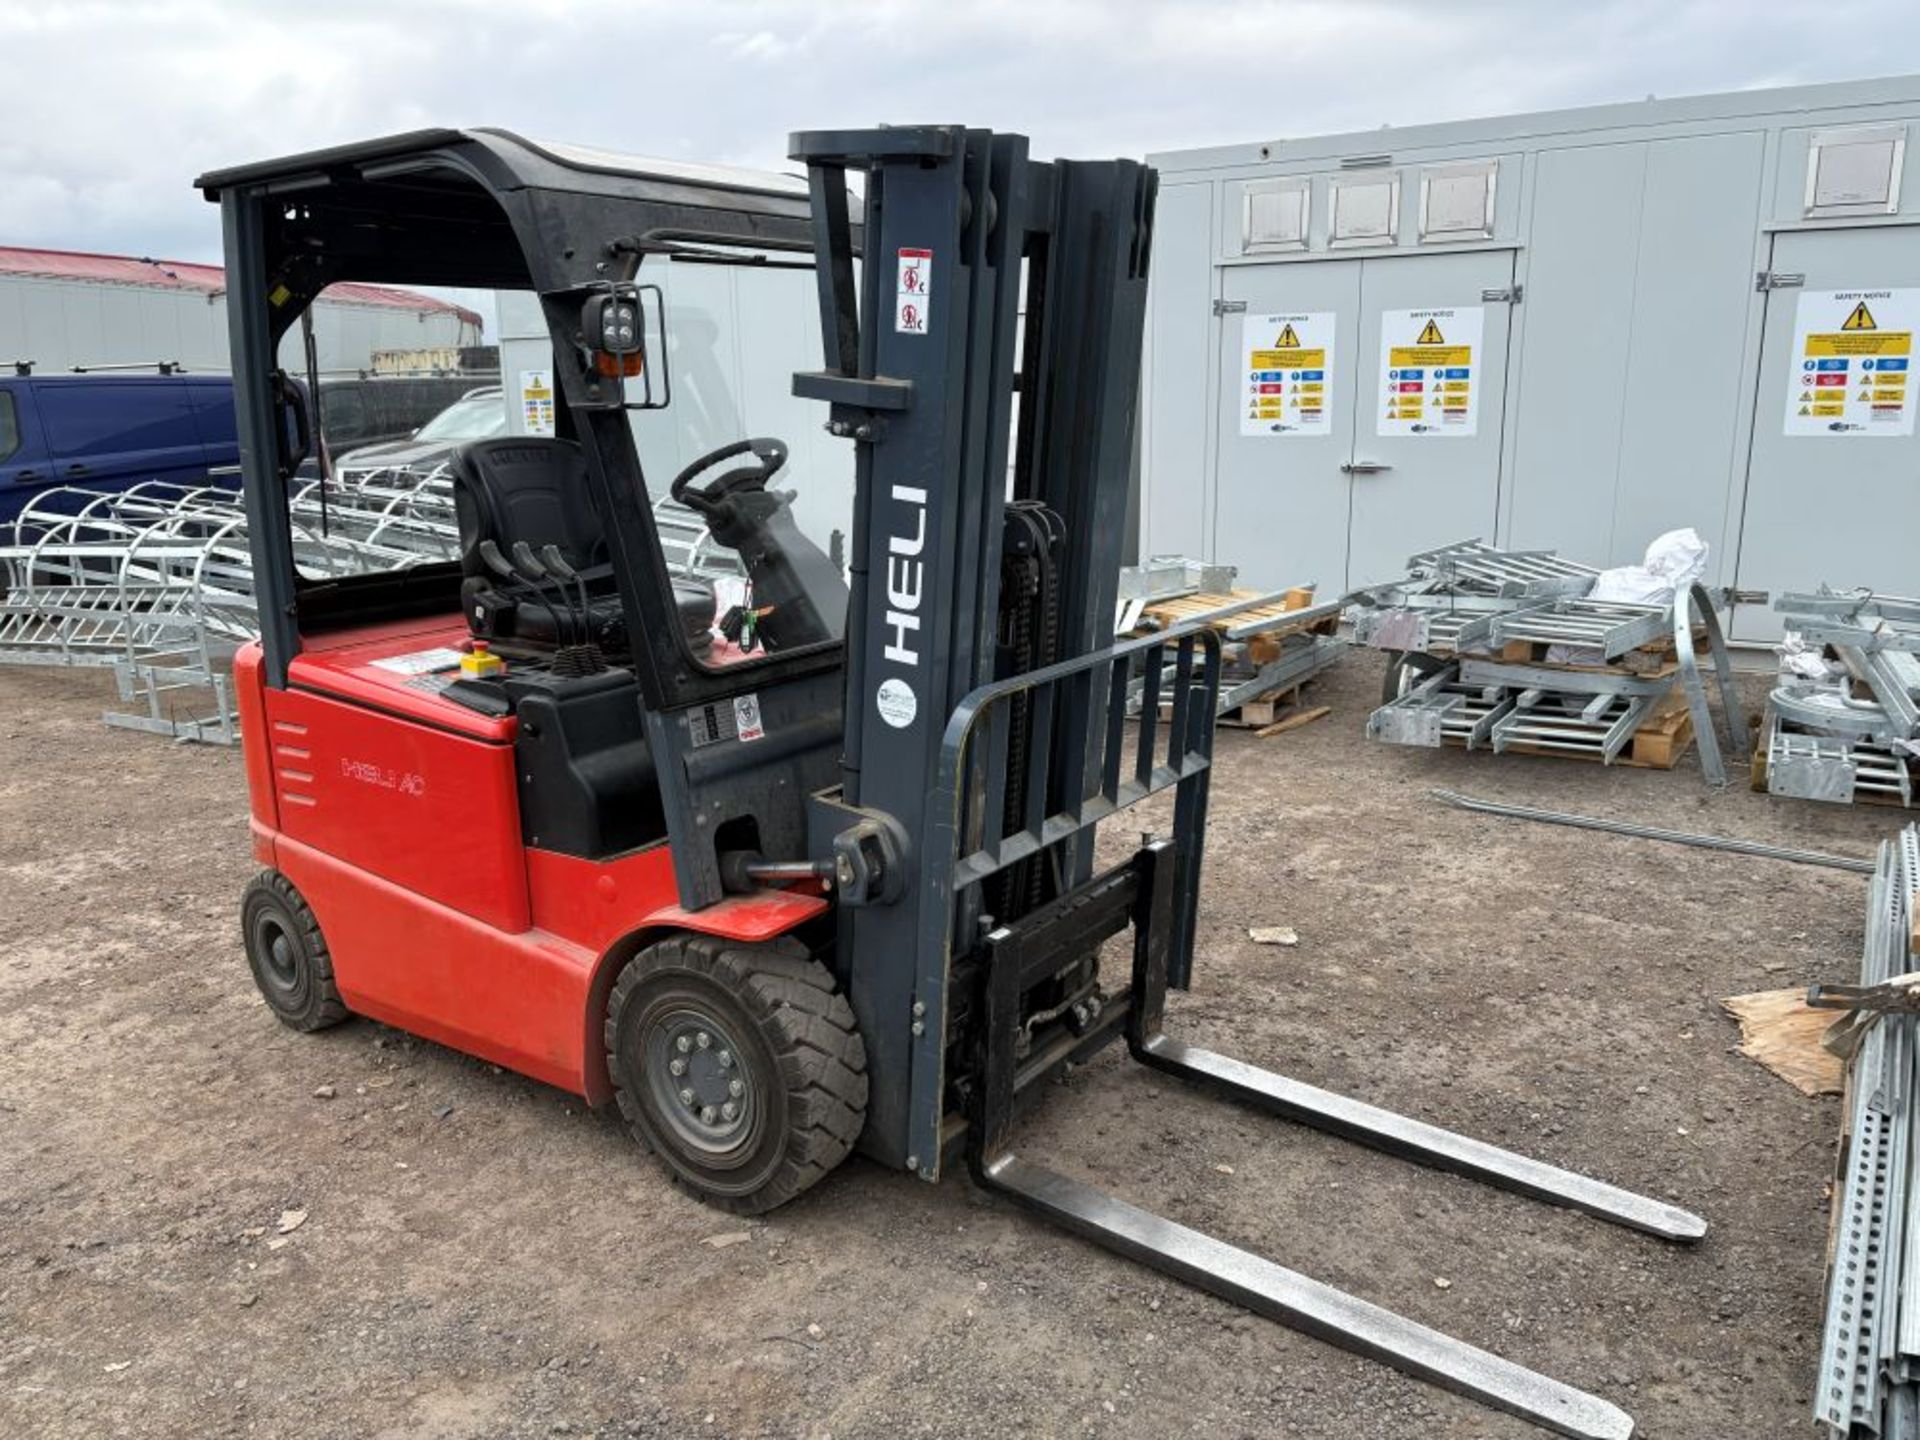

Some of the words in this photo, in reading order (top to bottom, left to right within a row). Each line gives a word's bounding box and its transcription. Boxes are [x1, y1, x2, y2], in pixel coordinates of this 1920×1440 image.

[1863, 291, 1892, 299] NOTICE
[883, 484, 928, 665] HELI
[340, 758, 397, 788] HELI
[398, 773, 426, 796] AC
